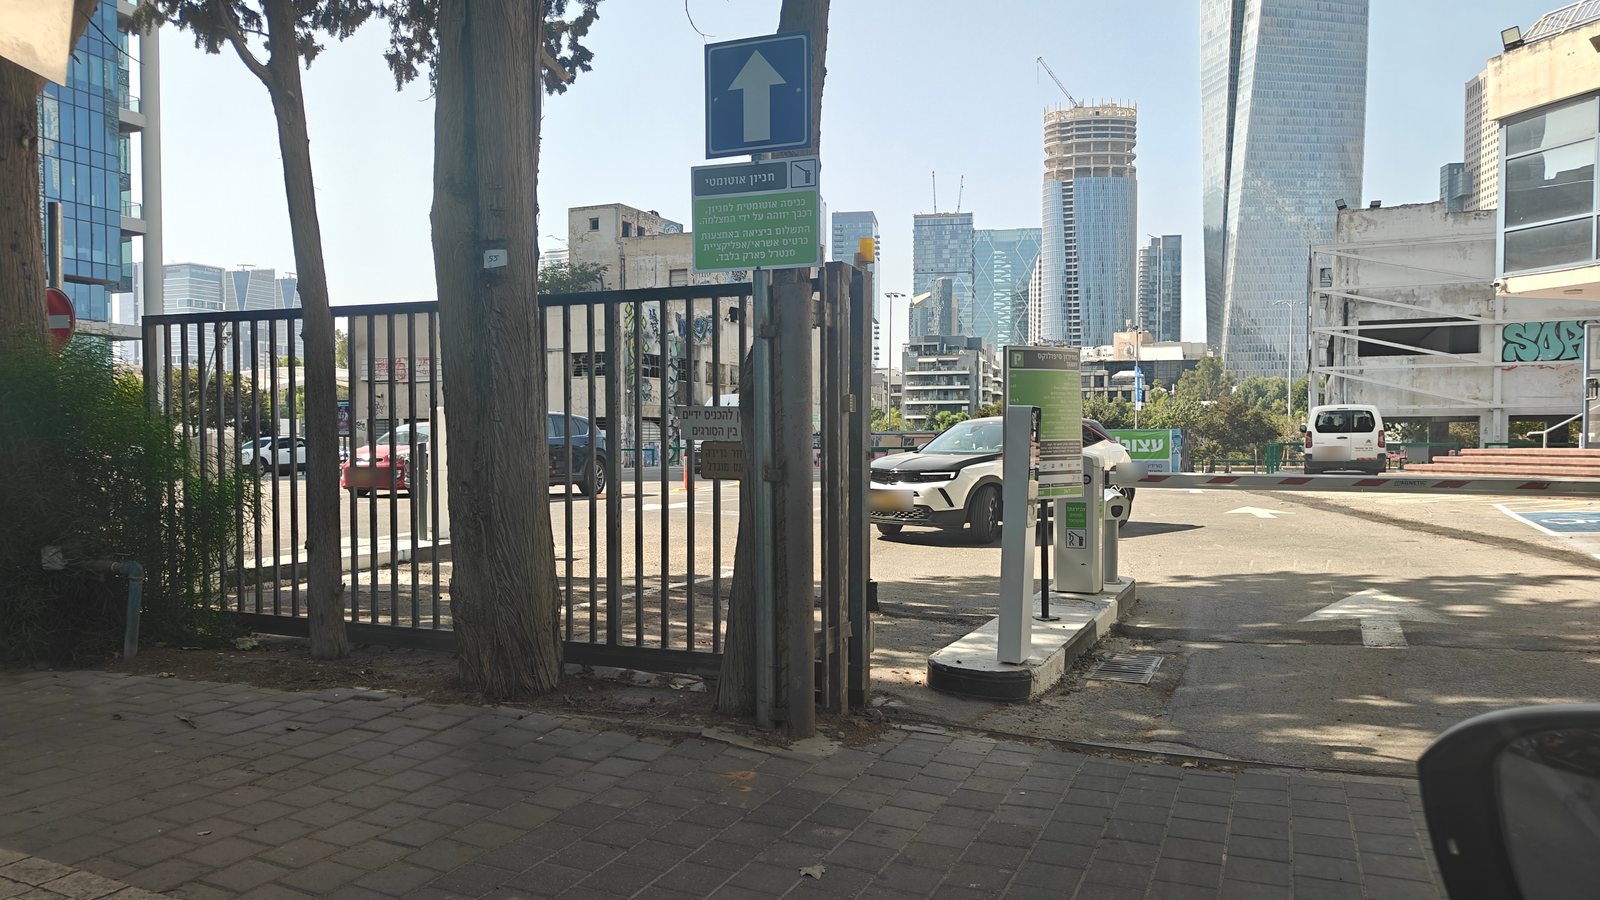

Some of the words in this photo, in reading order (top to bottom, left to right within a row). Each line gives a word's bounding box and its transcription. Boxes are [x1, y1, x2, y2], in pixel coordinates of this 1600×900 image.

[704, 175, 746, 187] אוטומטי
[749, 172, 775, 186] חניון
[737, 200, 778, 211] אוטומטית
[780, 198, 806, 207] כניסה
[738, 214, 750, 222] ידי
[752, 212, 764, 221] על
[767, 212, 789, 220] יזוהה
[791, 209, 812, 219] רכבך
[742, 228, 772, 237] ביציאה
[776, 225, 811, 235] התשלום
[701, 230, 740, 241] באמצעות
[782, 237, 808, 246] כרטיס
[742, 251, 766, 262] פארק
[768, 249, 796, 258] סנטרל
[1014, 353, 1022, 365] P
[682, 410, 701, 420] ידיים
[704, 408, 733, 420] להכניס
[692, 426, 724, 436] הסורגים
[727, 426, 738, 439] בין
